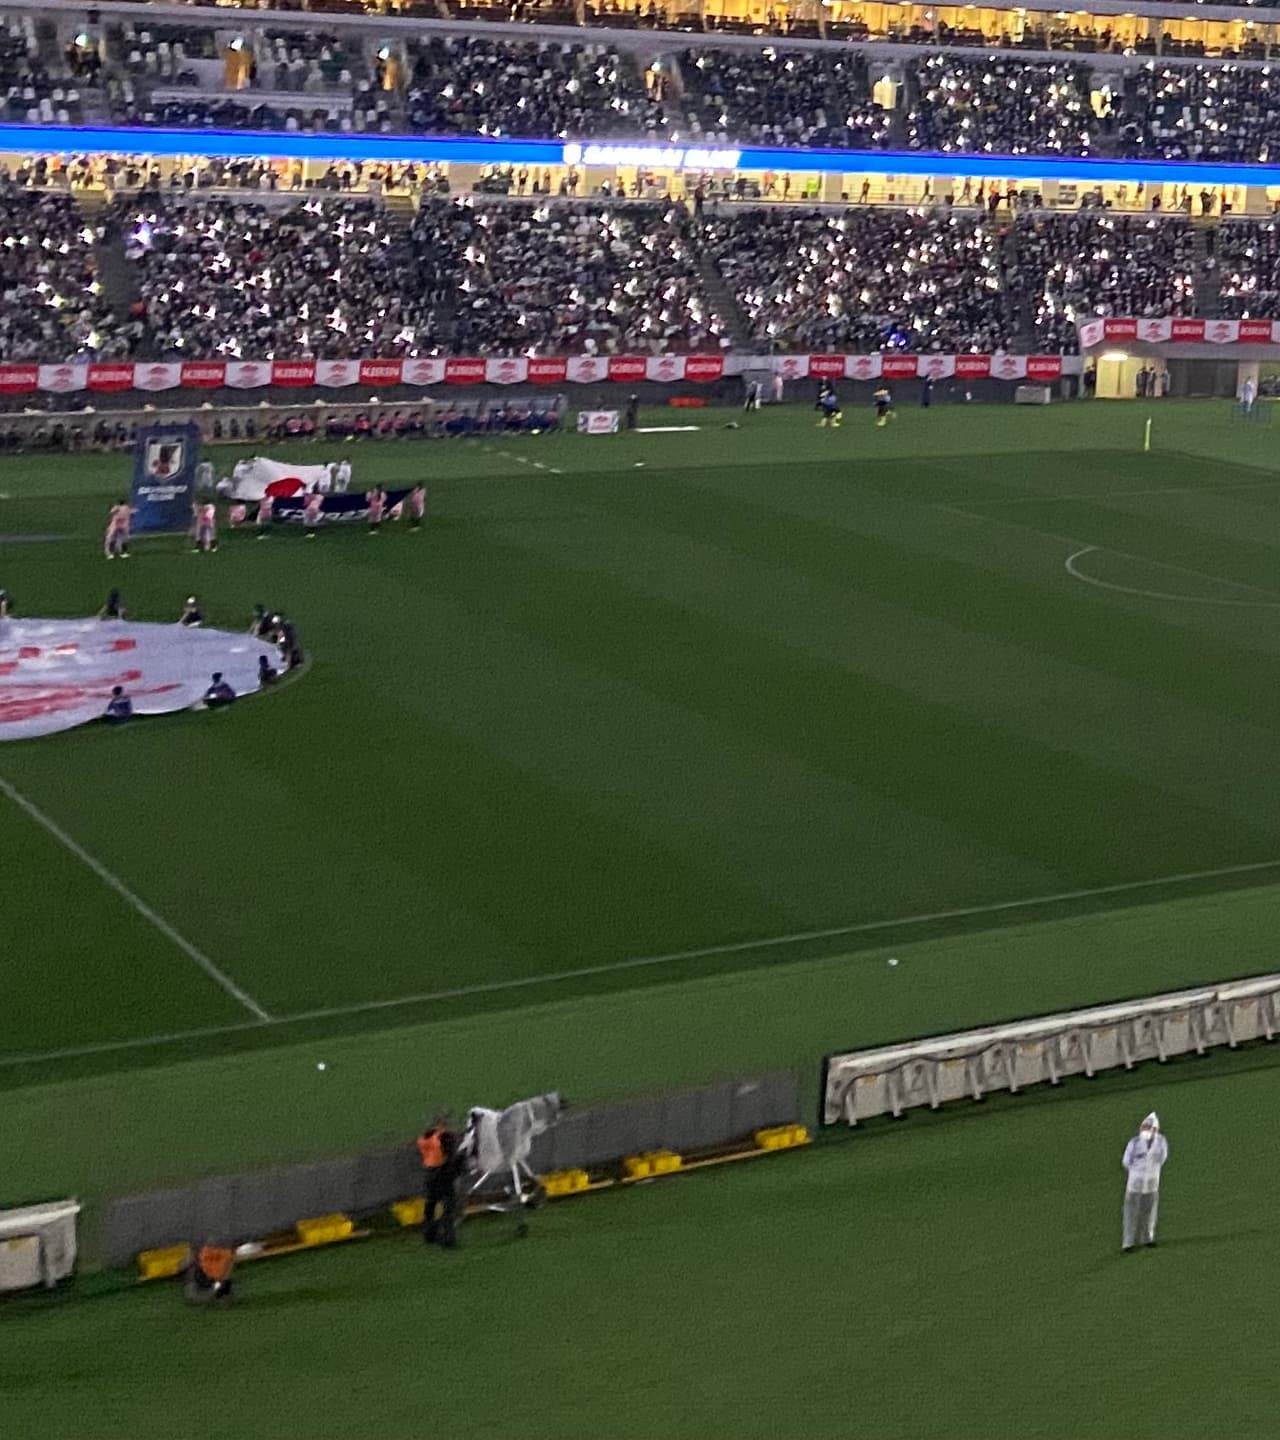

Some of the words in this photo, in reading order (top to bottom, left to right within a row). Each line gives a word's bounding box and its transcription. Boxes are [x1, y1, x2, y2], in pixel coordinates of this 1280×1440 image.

[1105, 324, 1136, 334] KIRIN
[1173, 325, 1204, 335] KIRIN
[1240, 326, 1271, 336] KIRIN
